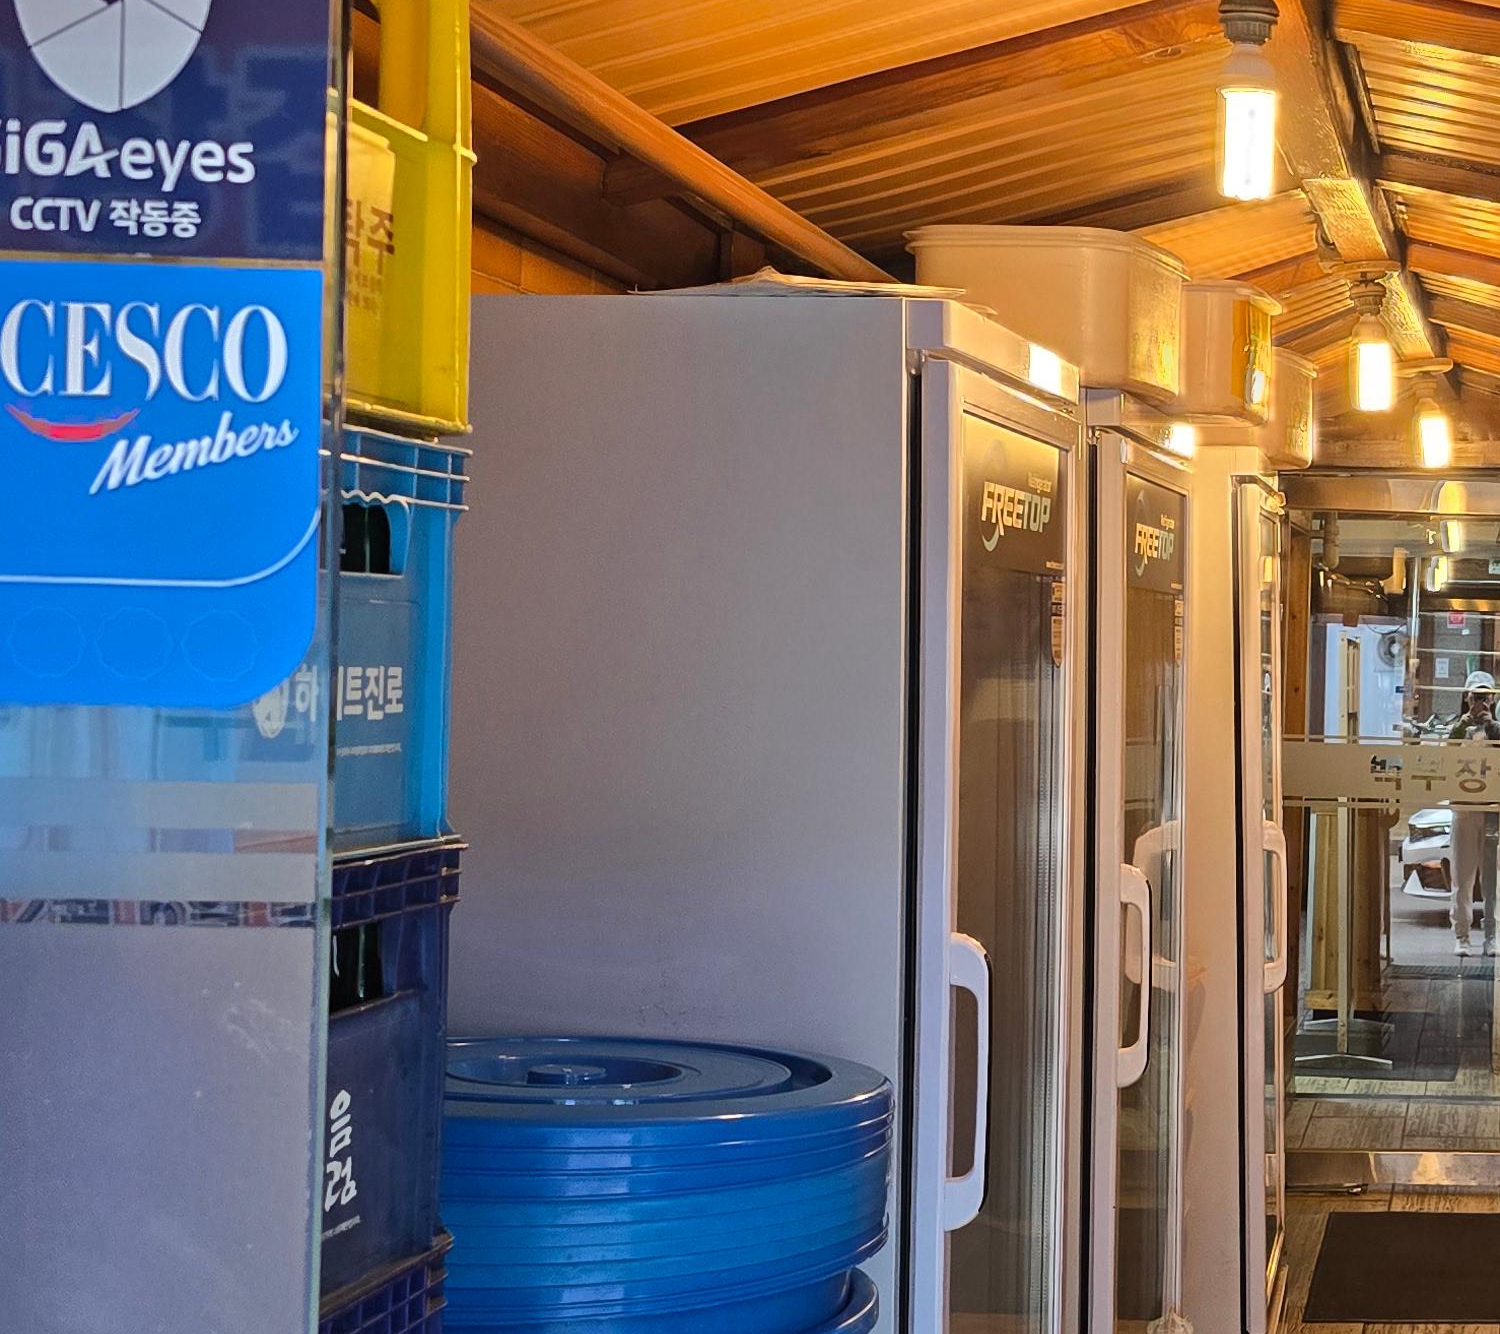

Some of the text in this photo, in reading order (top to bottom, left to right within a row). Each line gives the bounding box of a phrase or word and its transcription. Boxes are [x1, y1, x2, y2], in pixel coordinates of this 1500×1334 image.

[0, 118, 256, 192] iGAeyes
[10, 196, 202, 238] CCTV 작동중
[0, 298, 288, 403] CESCO
[88, 411, 300, 496] Members
[981, 481, 1051, 536] FREETOP
[1134, 522, 1175, 565] FREETOP
[329, 1089, 352, 1158] 음
[324, 1155, 358, 1212] 럼
